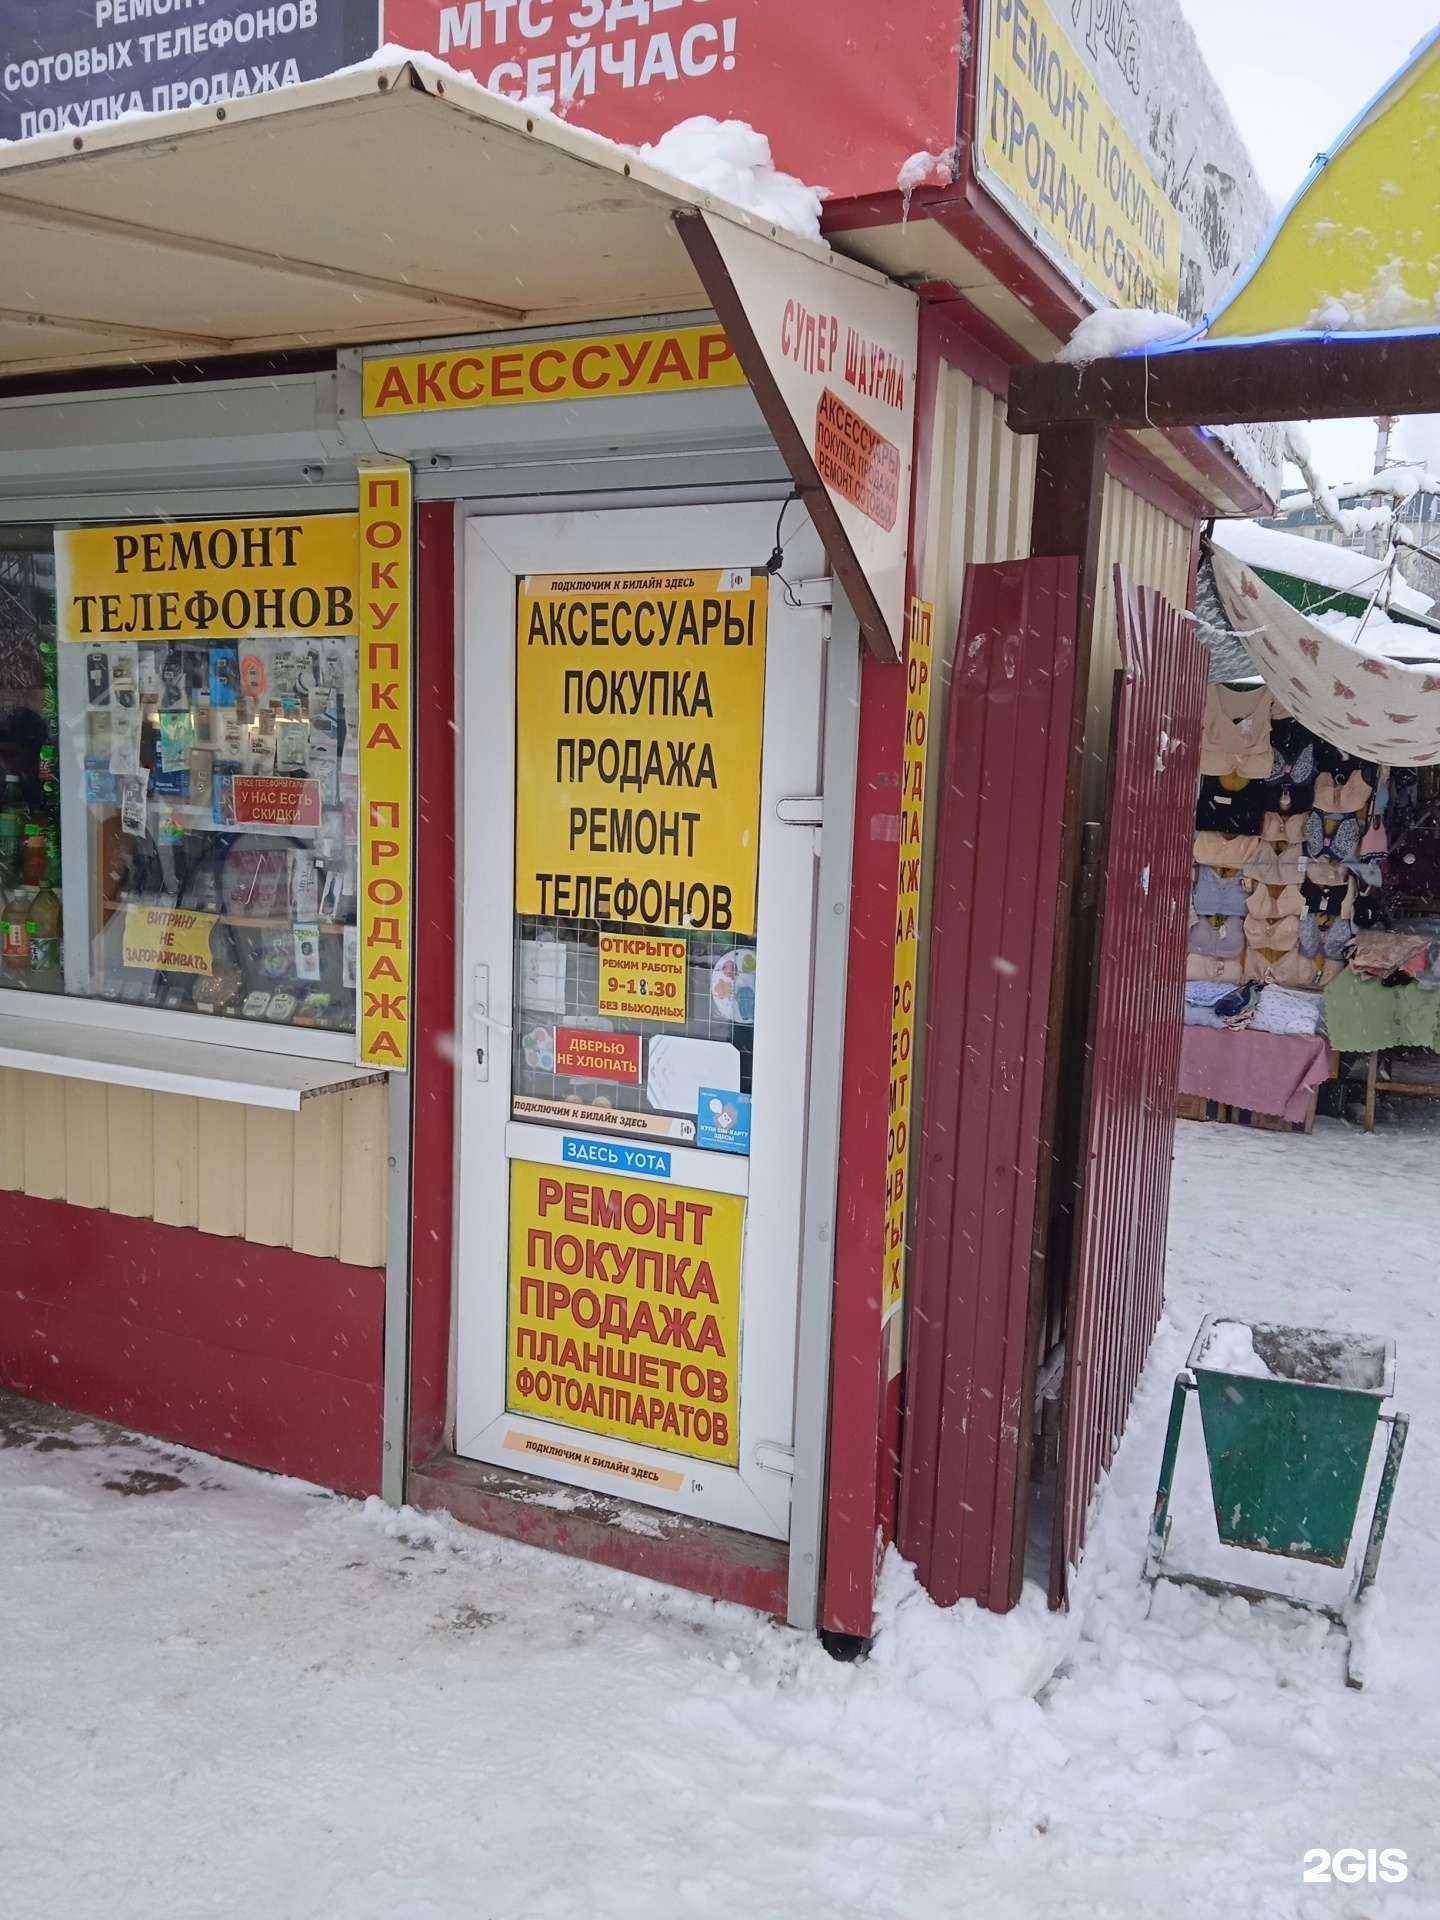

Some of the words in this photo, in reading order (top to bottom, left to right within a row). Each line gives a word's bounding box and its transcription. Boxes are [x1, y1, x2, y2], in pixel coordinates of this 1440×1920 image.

[96, 0, 206, 29] РЕМО
[439, 0, 553, 54] МТС
[5, 40, 132, 91] СОТОВЫХ
[139, 1, 318, 62] ТЕЛЕФОНОВ
[487, 17, 737, 104] СЕЙЧАС!
[20, 91, 145, 139] ПОКУПКА
[153, 58, 301, 112] ПРОДАЖА
[996, 0, 1088, 153] РЕМОНТ
[1097, 123, 1166, 269] ПОКУПКА
[991, 72, 1097, 263] ПРОДАЖА
[781, 298, 838, 376] СУПЕР
[844, 326, 905, 411] ШАУРМА
[817, 421, 857, 473] ПОКУПКА
[819, 450, 854, 495] РЕМОНТ
[114, 526, 303, 573] РЕМОНТ
[551, 580, 611, 591] ПОДКЛЮЧИМ
[613, 579, 620, 590] К
[622, 577, 662, 589] БИЛАЙН
[665, 577, 695, 588] ЗДЕСЬ
[74, 586, 353, 632] ТЕЛЕФОНОВ
[365, 480, 401, 750] ПОКУПКА
[528, 600, 755, 646] АКСЕССУАРЫ
[564, 669, 713, 718] ПОКУПКА
[557, 738, 718, 793] ПРОДАЖА
[905, 611, 931, 940] ПРОДАЖА
[241, 792, 248, 802] У
[251, 791, 276, 804] НАС
[280, 792, 313, 806] ЕСТЬ
[570, 807, 701, 857] РЕМОНТ
[147, 912, 197, 929] ВИТРИНУ
[535, 873, 732, 930] ТЕЛЕФОНОВ
[160, 932, 175, 946] НЕ
[364, 801, 406, 1058] ПРОДАЖА
[600, 937, 685, 958] ОТКРЫТО
[125, 947, 208, 971] ЗАГОРАЖИВАТЬ
[602, 959, 639, 970] РЕЖИМ
[642, 962, 682, 974] РАБОТЫ
[600, 1000, 618, 1010] БЕЗ
[621, 1002, 684, 1018] ВЫХОДНЫХ
[608, 977, 677, 998] 9-18.30
[557, 1053, 574, 1065] НЕ
[576, 1056, 637, 1073] ХЛОПАТЬ
[569, 1038, 625, 1055] ДВЕРЬЮ
[514, 1101, 570, 1117] ПОДКЛЮЧИМ
[580, 1111, 618, 1125] БИЛАЙН
[619, 1117, 648, 1128] ЗДЕСЬ
[890, 980, 912, 1295] СОТОВЫХ
[567, 1142, 618, 1163] ЗДЕСЬ
[624, 1151, 666, 1171] YOTA
[538, 1177, 712, 1245] РЕМОНТ
[527, 1228, 720, 1304] ПОКУПКА
[519, 1276, 726, 1357] ПРОДАЖА
[517, 1327, 729, 1403] ПЛАНШЕТОВ
[516, 1366, 729, 1446] ФОТОАППАРАТОВ
[526, 1440, 582, 1462] ПОДКЛЮЧИМ
[583, 1455, 590, 1463] К
[592, 1457, 629, 1474] БИЛАЙН
[631, 1467, 659, 1481] ЗДЕСЬ
